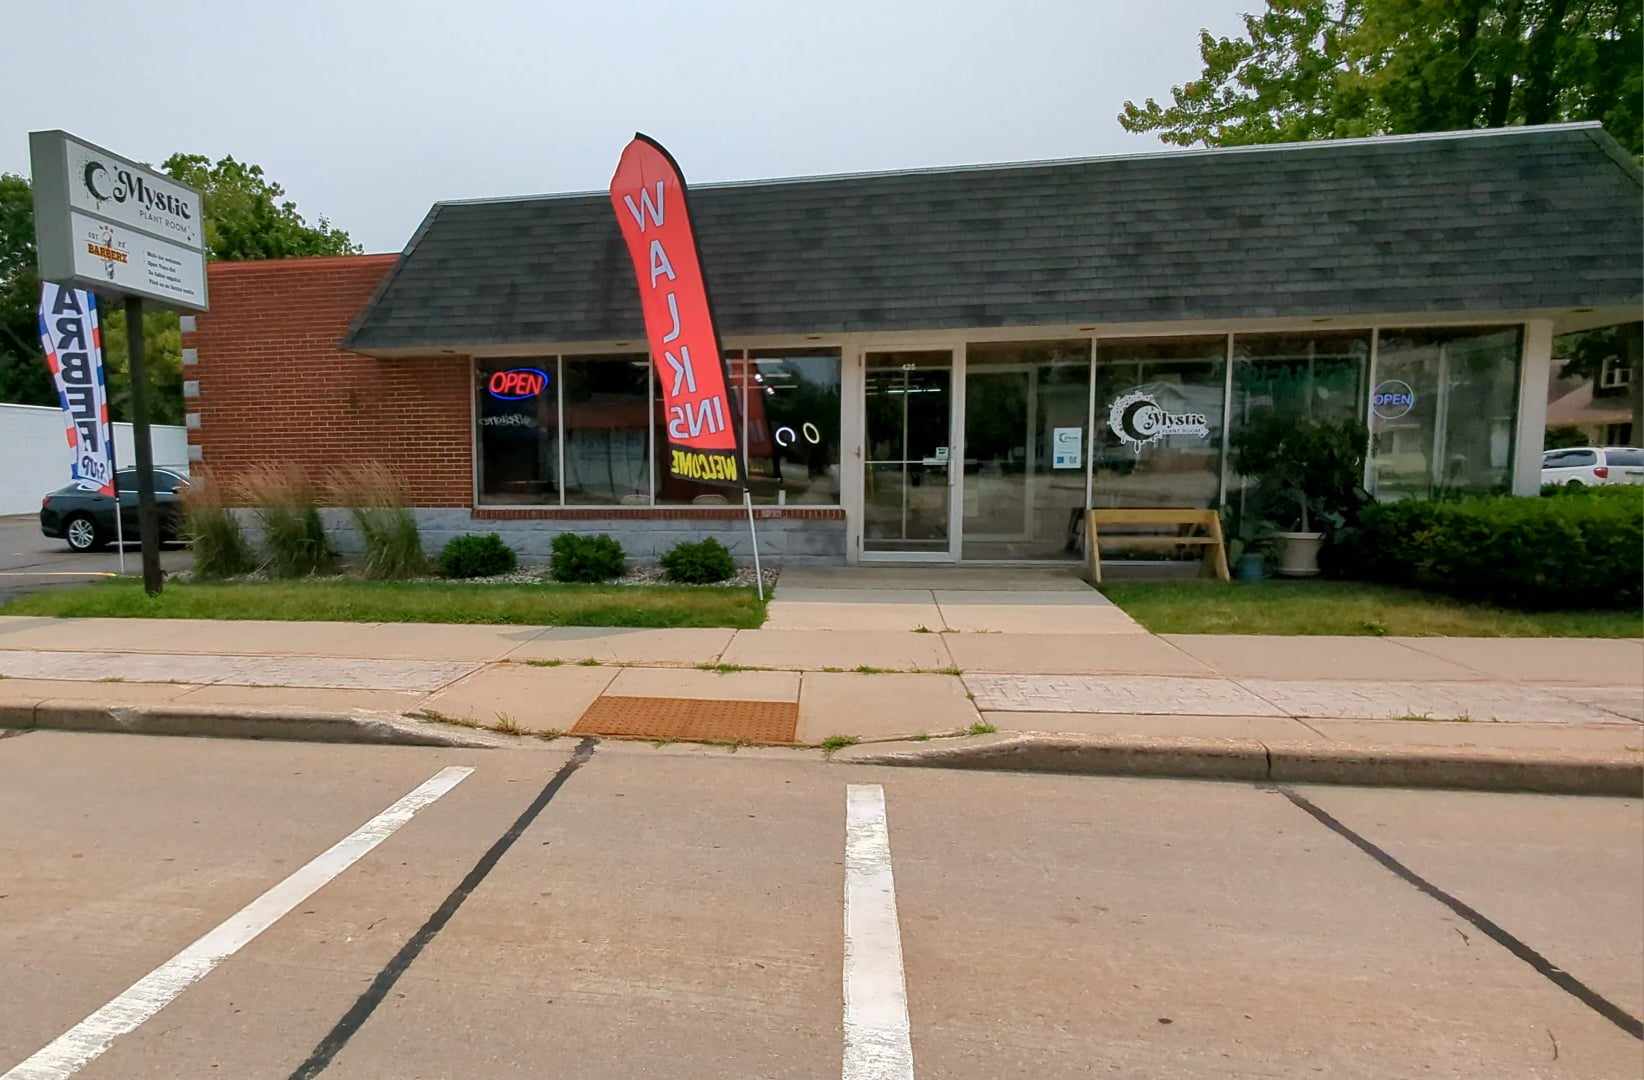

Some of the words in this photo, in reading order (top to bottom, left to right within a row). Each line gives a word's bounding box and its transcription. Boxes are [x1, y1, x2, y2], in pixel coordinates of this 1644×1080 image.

[112, 170, 191, 220] Mystic
[139, 209, 163, 225] PLANT
[164, 218, 188, 234] ROOM
[489, 371, 543, 396] OPEN
[1374, 393, 1412, 406] OPEN
[1143, 412, 1205, 430] Mystic
